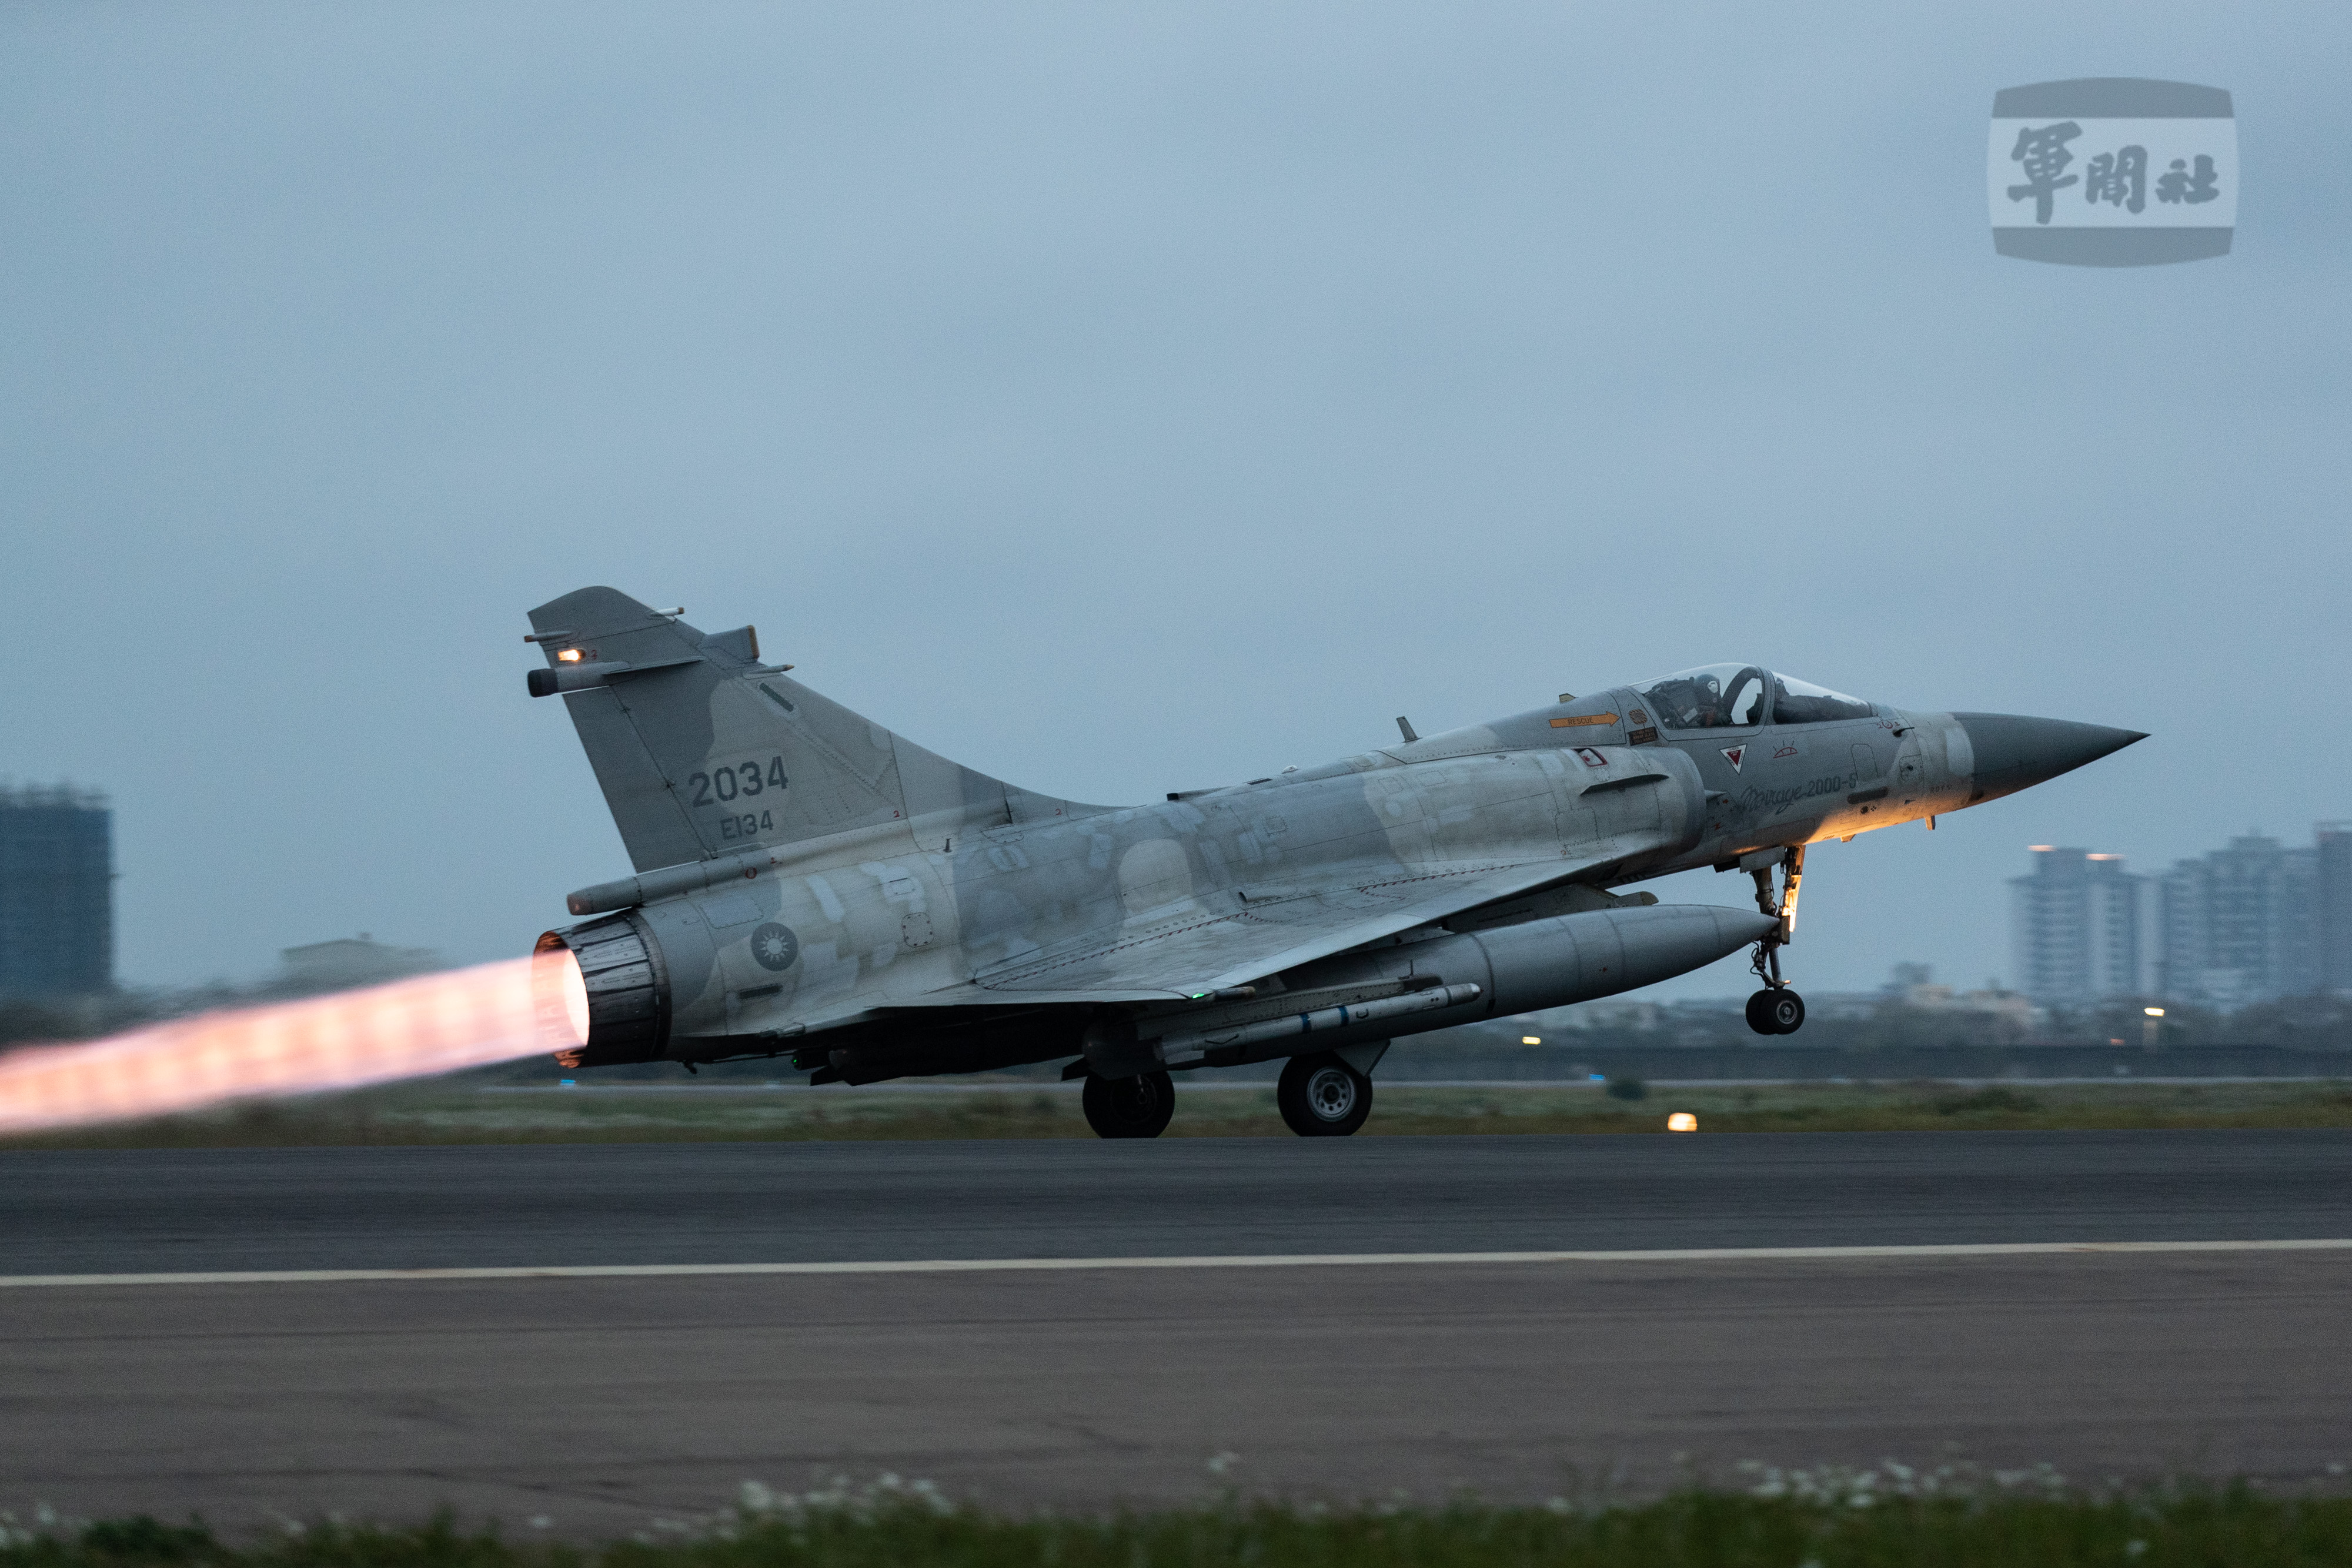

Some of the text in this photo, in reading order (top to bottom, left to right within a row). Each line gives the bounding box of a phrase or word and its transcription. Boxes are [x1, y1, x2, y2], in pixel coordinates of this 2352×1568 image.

[1567, 717, 1594, 726] RESCUE
[688, 755, 789, 808] 2034
[1740, 772, 1857, 815] Mirage 2000-5
[720, 810, 774, 840] E134
